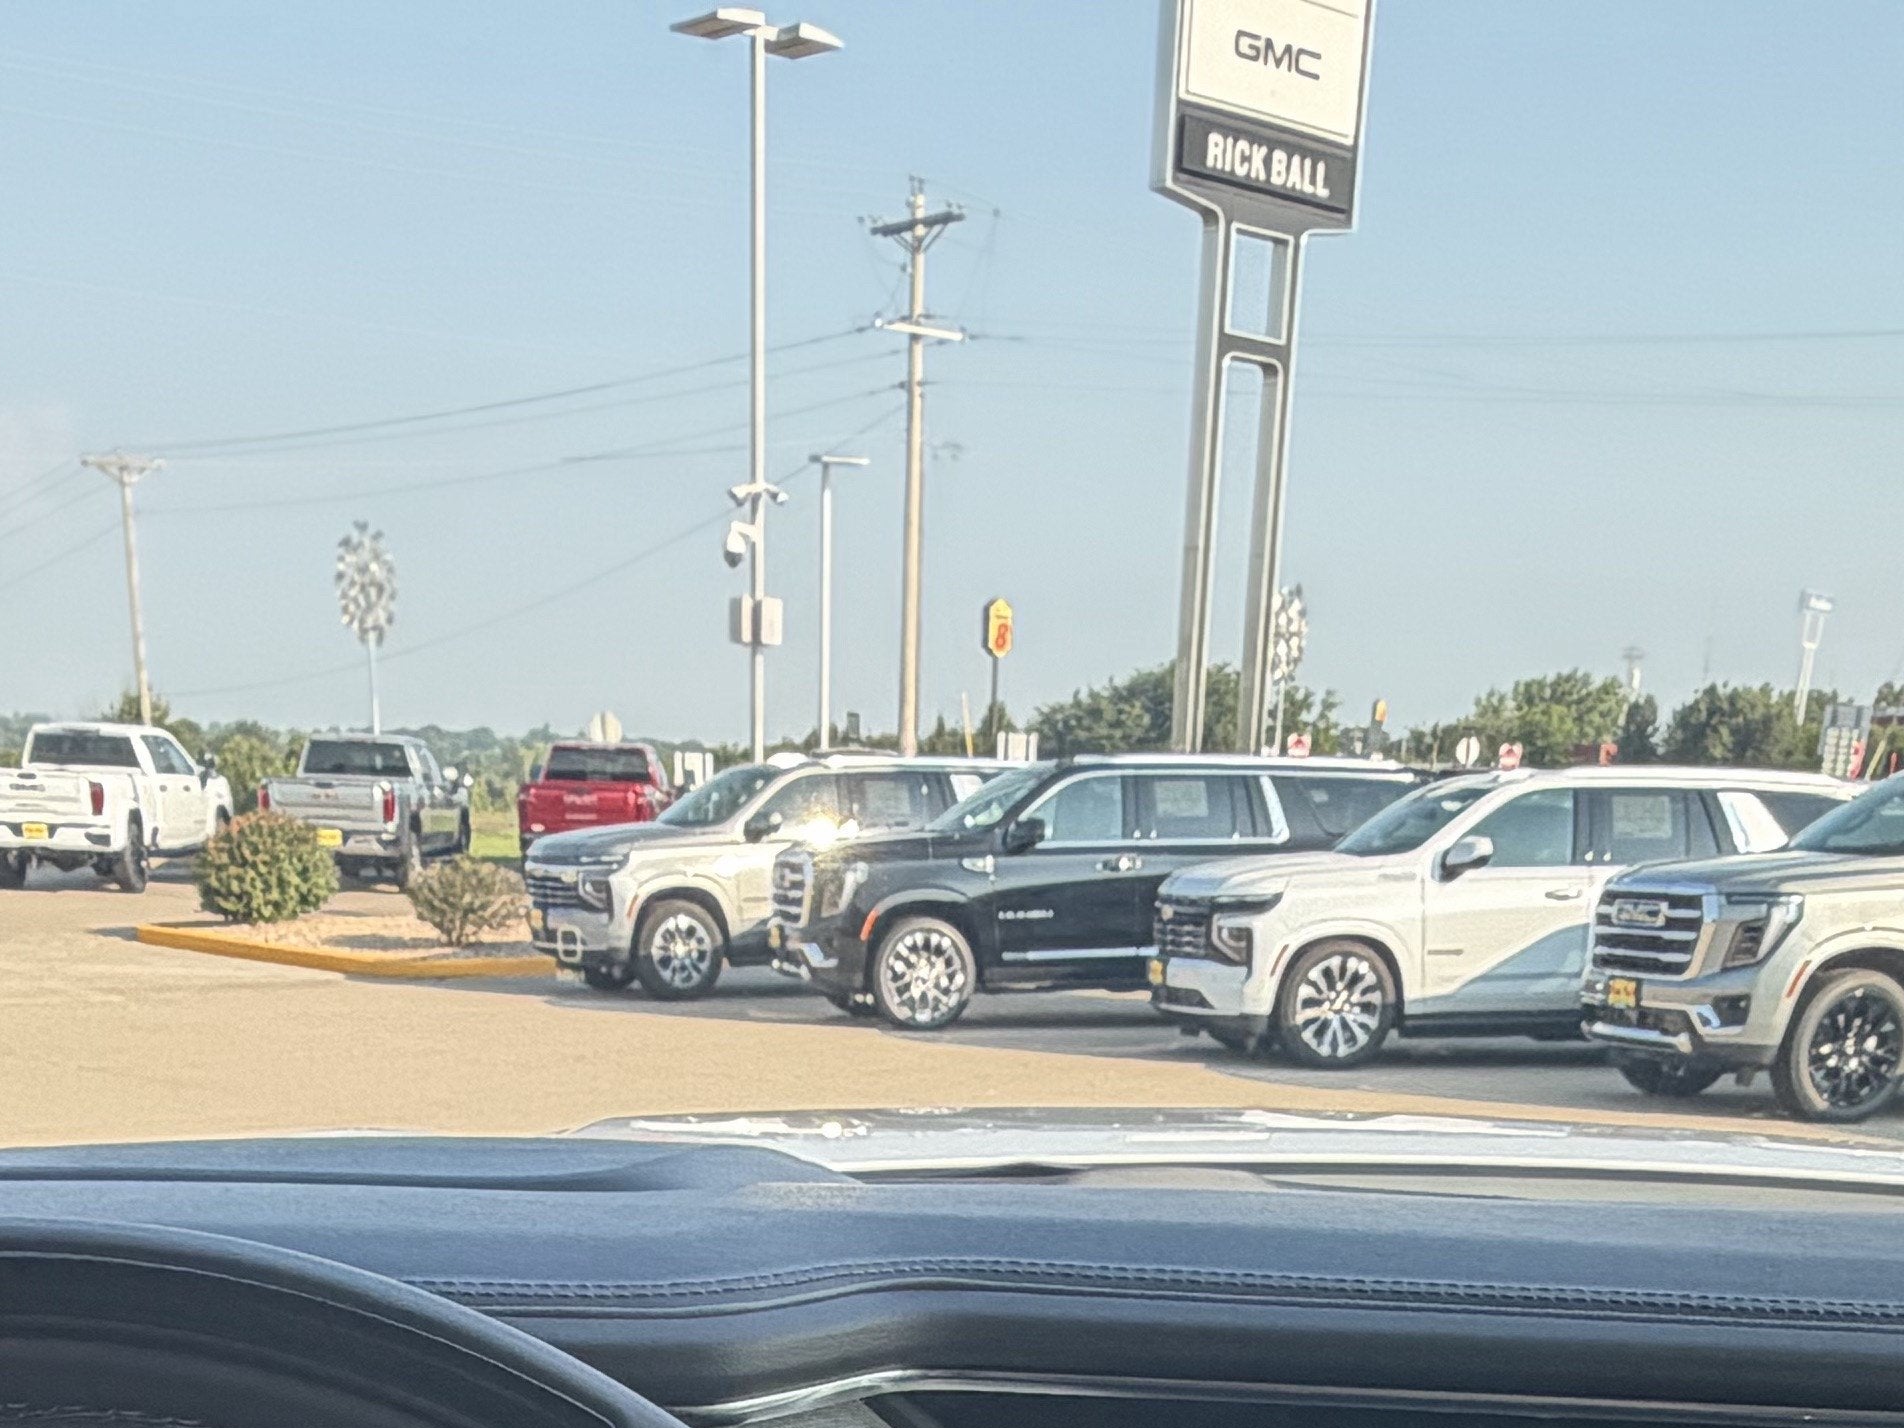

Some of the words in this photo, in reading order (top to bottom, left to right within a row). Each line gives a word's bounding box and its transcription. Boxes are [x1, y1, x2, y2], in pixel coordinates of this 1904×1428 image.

[1234, 29, 1322, 81] GMC
[1205, 131, 1269, 182] RICK
[1270, 148, 1331, 200] BALL
